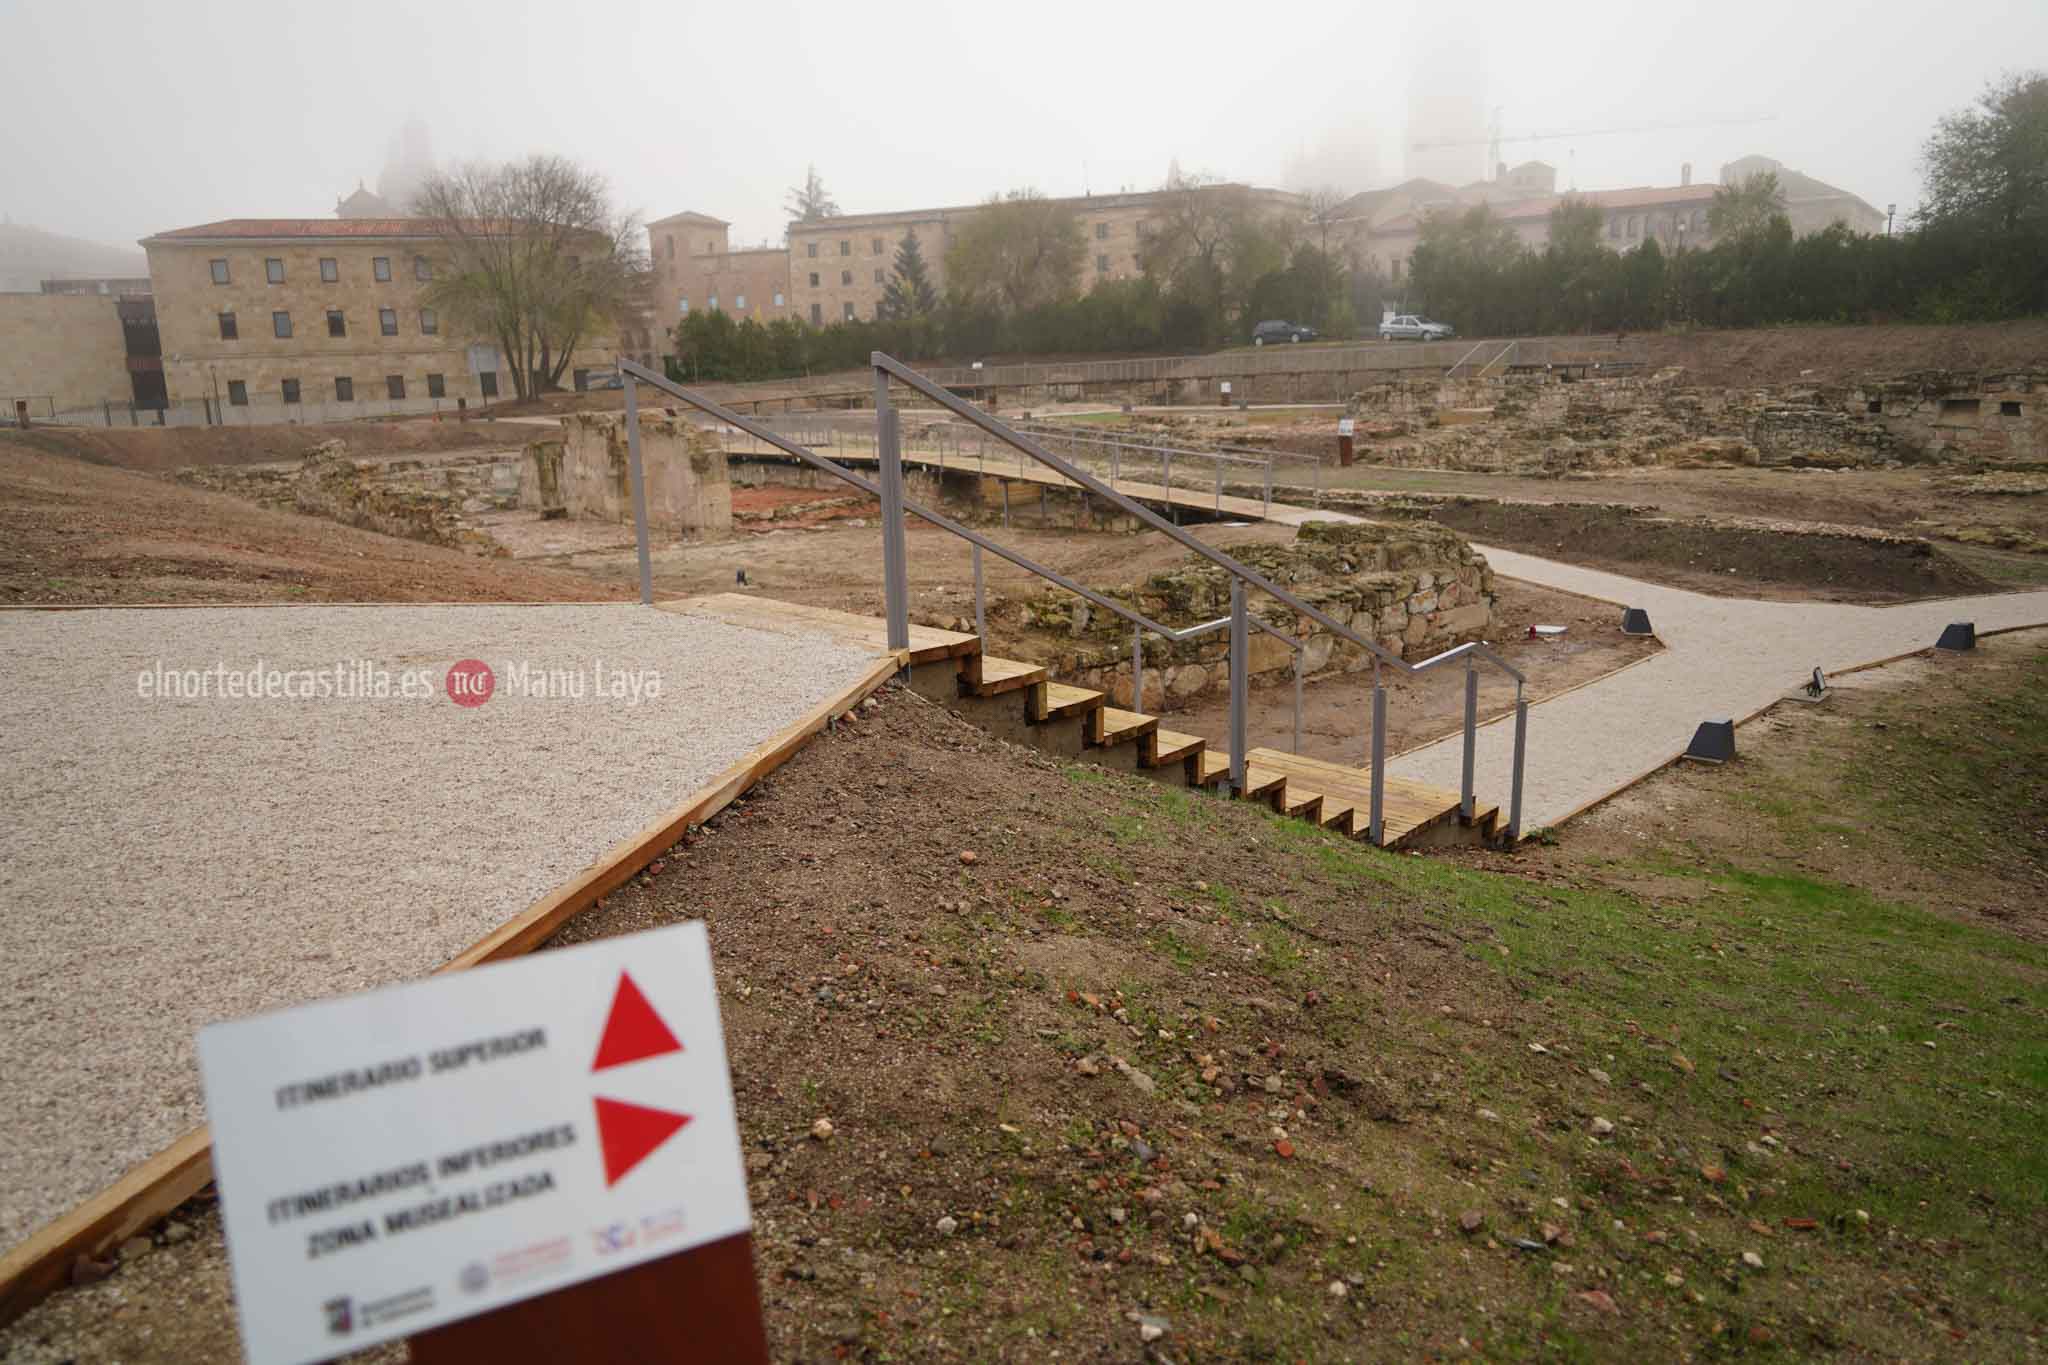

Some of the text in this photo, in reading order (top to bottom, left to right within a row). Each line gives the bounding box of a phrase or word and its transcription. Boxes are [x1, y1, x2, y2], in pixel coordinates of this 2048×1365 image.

[276, 1027, 546, 1110] ITINERARIO SUPERIOR
[268, 1123, 577, 1225] ITINERARIOS INFERIORES
[307, 1212, 376, 1259] ZONA
[385, 1172, 556, 1238] MUSEALIZADA
